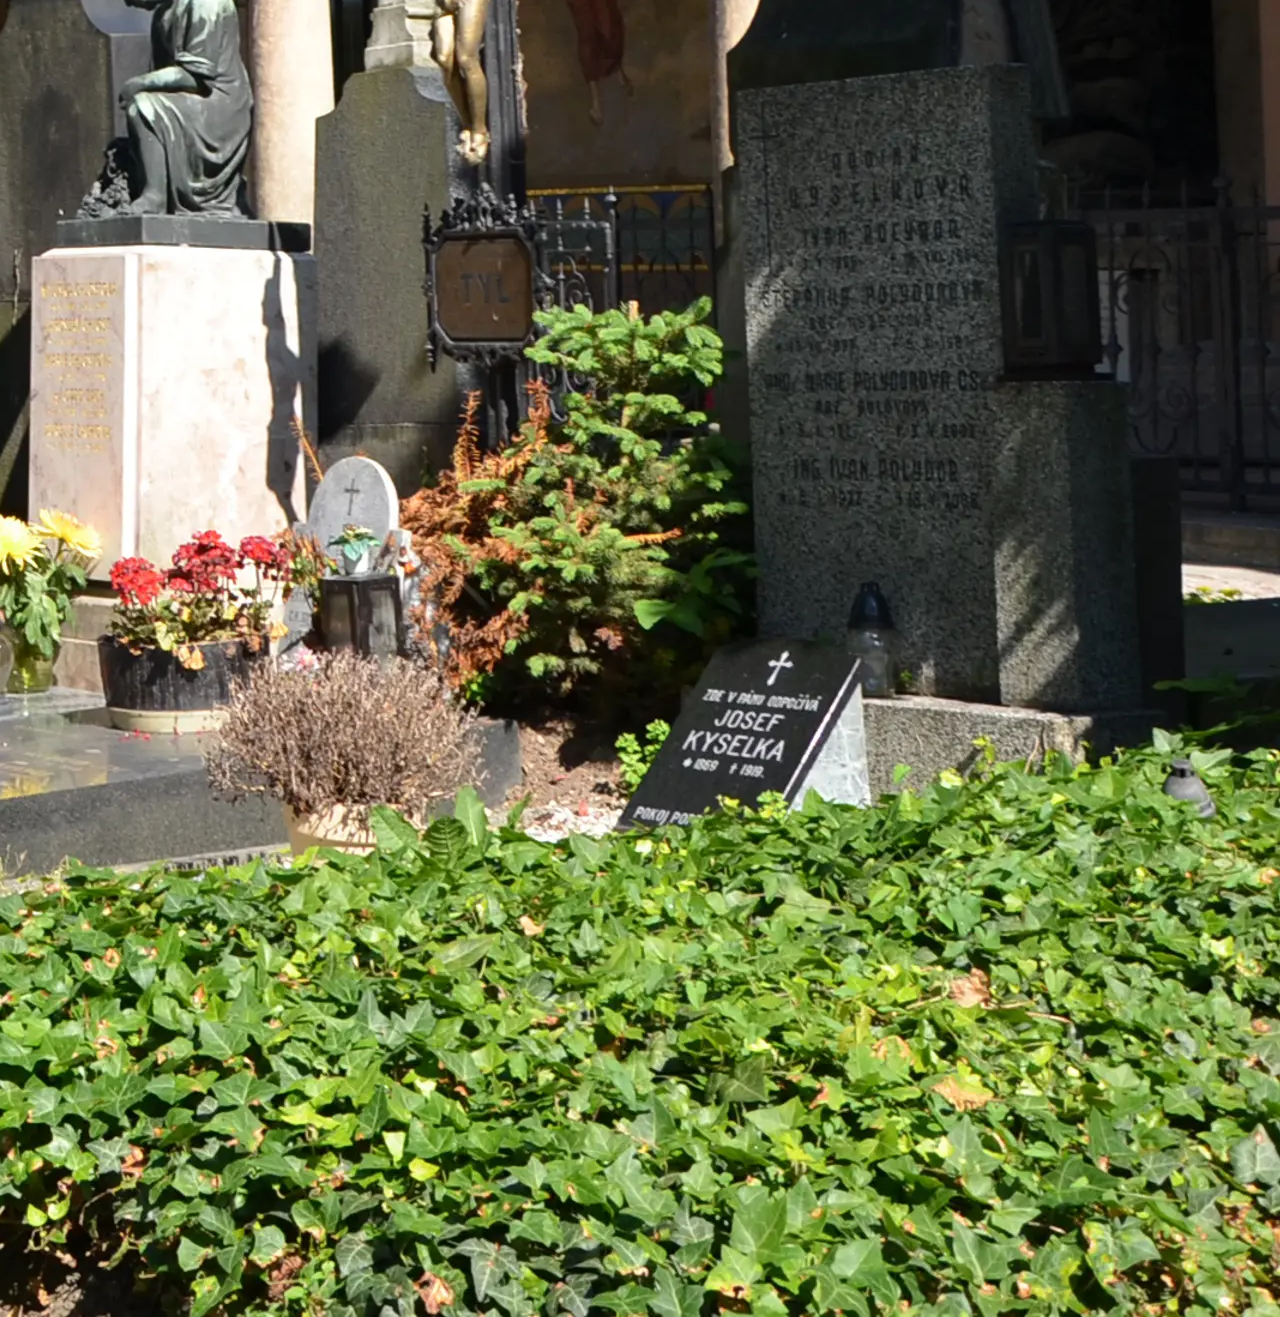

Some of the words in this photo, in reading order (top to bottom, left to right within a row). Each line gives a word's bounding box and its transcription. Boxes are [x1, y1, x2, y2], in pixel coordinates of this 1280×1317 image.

[460, 273, 511, 303] TYL
[702, 689, 727, 702] ZDE
[727, 690, 737, 702] V
[714, 709, 785, 732] JOSEF
[682, 730, 786, 762] KYSELKA
[632, 806, 669, 825] POKOJ
